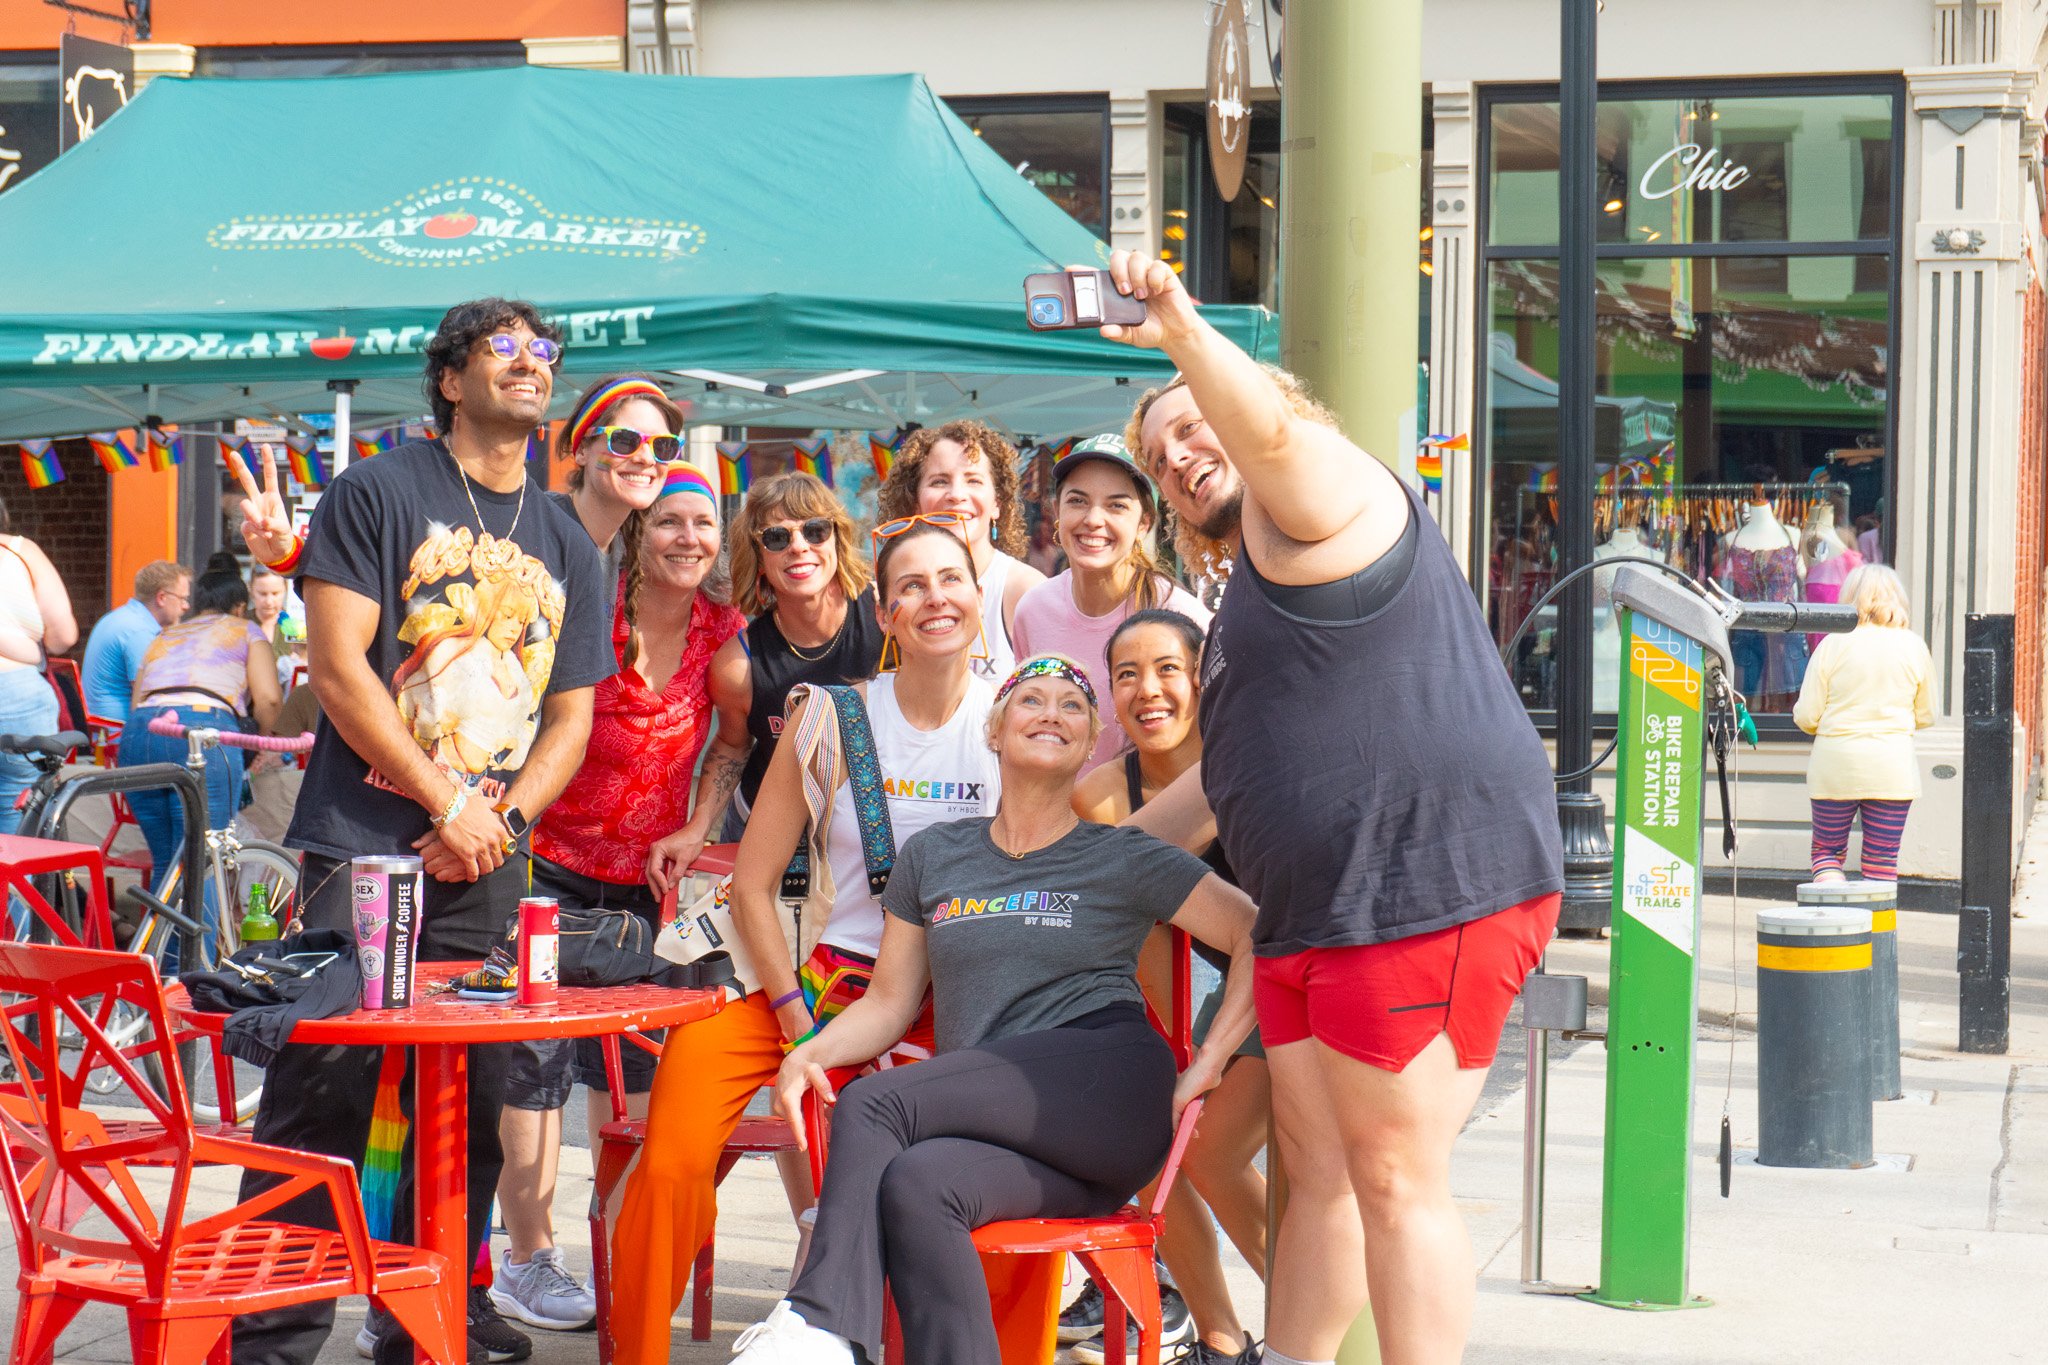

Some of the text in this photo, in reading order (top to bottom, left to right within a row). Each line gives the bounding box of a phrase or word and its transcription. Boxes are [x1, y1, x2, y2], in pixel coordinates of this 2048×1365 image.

[1639, 143, 1751, 200] Chic
[401, 188, 525, 218] SINCE 1852
[221, 216, 692, 250] FINDLAY MARKET
[378, 238, 508, 259] CINCINNATI
[360, 306, 656, 356] MET
[1663, 715, 1683, 827] BIKE REPAIR
[883, 777, 981, 800] ANCEFIX
[1643, 749, 1661, 826] STATION
[355, 885, 374, 895] SEX
[1627, 885, 1691, 897] TRI STATE
[1024, 917, 1072, 928] BY HBDC
[392, 883, 411, 1000] SIDEWINDER COFFEE
